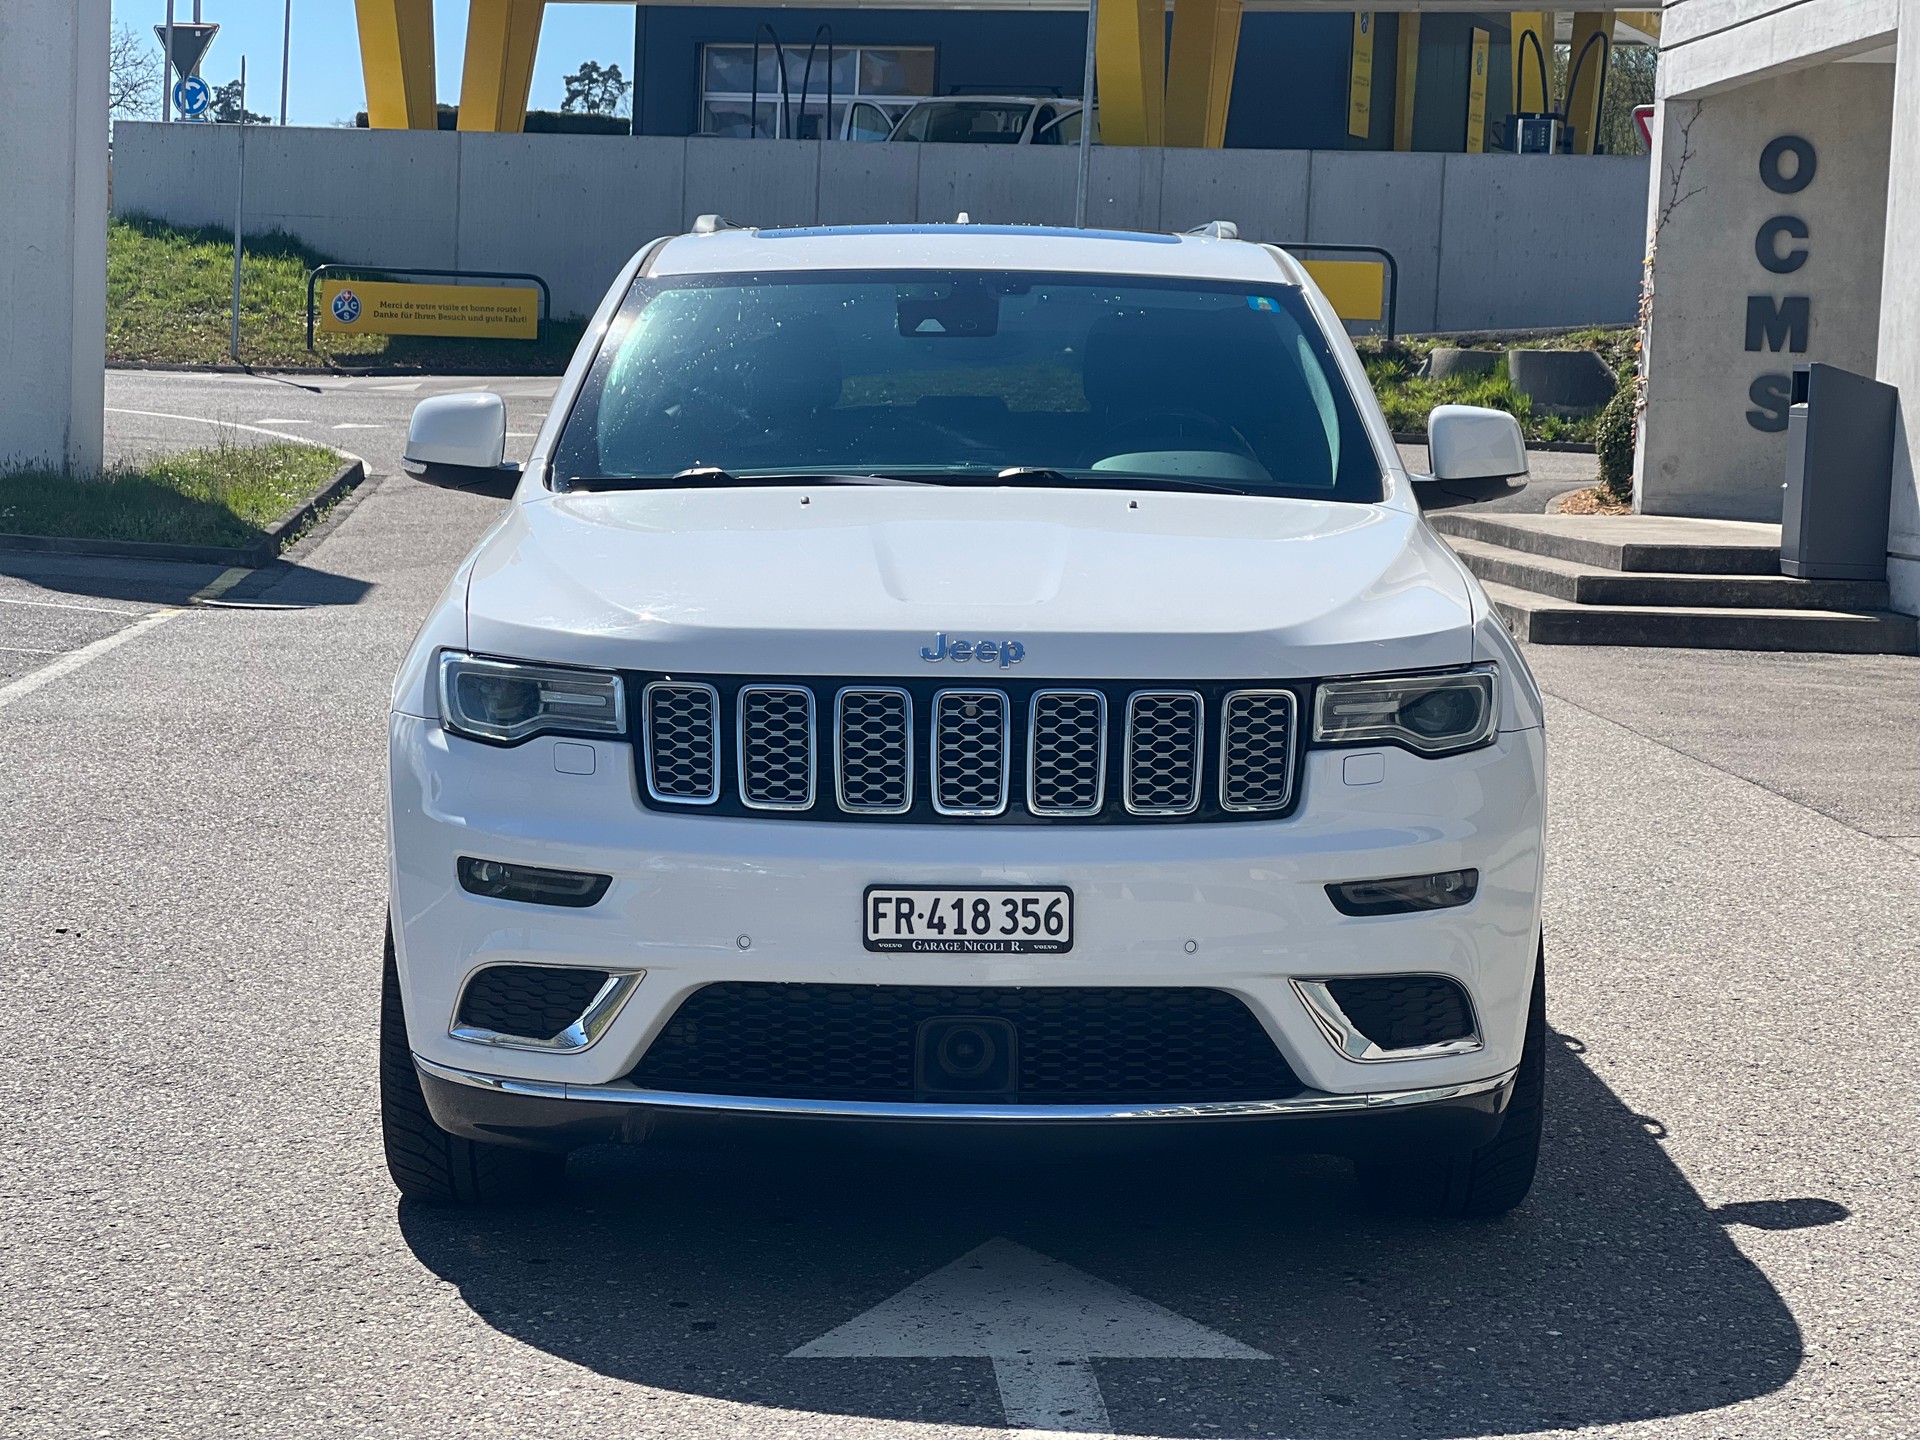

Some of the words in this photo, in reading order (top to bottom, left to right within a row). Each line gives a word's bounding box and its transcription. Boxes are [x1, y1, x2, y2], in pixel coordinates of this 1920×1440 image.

[1745, 135, 1817, 432] OCMS
[373, 310, 399, 319] Danke
[415, 312, 437, 320] Ihren
[438, 312, 467, 321] Besuch
[468, 314, 484, 322] und
[485, 315, 503, 323] gute
[504, 315, 528, 323] Fahrt!
[380, 301, 403, 309] Merci
[438, 303, 460, 311] visite
[470, 304, 495, 312] bonne
[920, 632, 1025, 669] Jeep
[1000, 897, 1064, 936] 356
[912, 940, 961, 951] GARAGE
[964, 940, 1004, 951] NICOLI
[1011, 941, 1024, 951] R.
